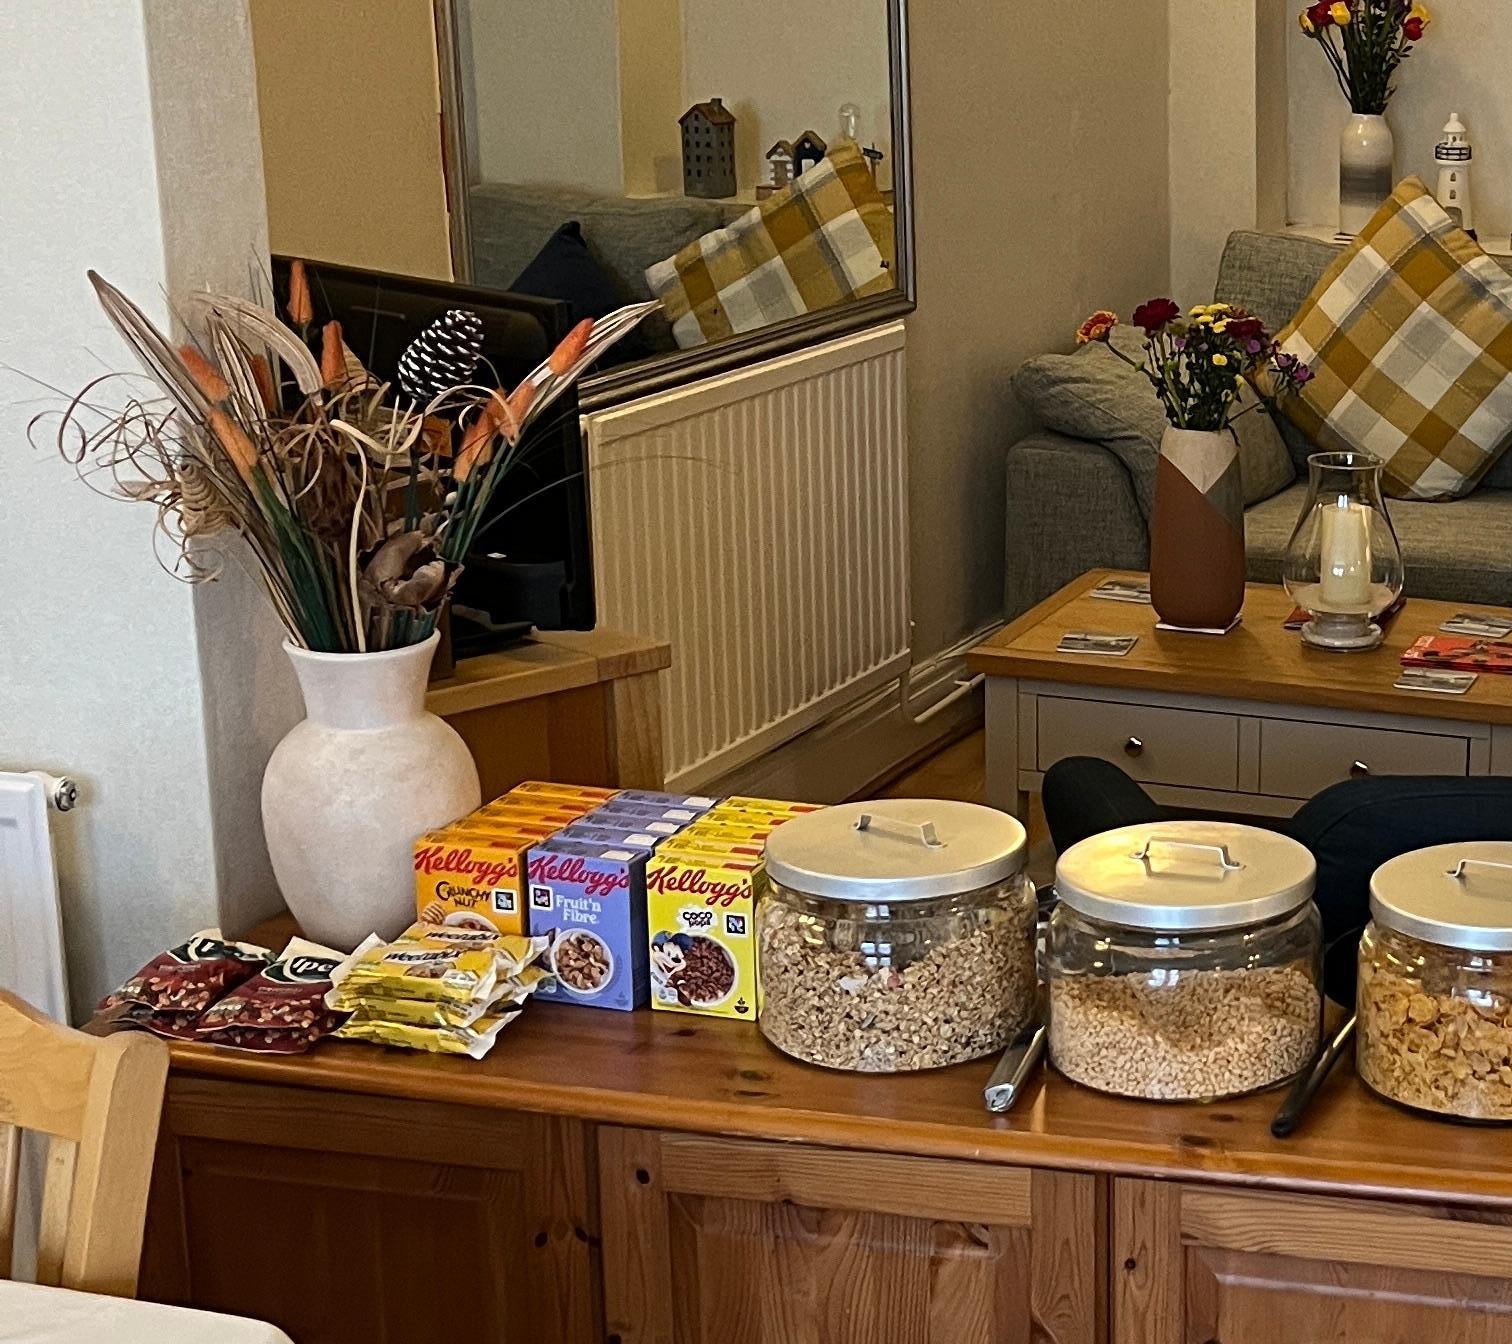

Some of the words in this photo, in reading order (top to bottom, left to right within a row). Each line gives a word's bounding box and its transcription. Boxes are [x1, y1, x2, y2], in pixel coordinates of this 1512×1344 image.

[414, 846, 519, 886] Kellogg's
[528, 855, 631, 896] Kellogg's
[646, 865, 753, 907] Kellogg's
[454, 895, 478, 908] NUT
[563, 908, 598, 924] Fibre
